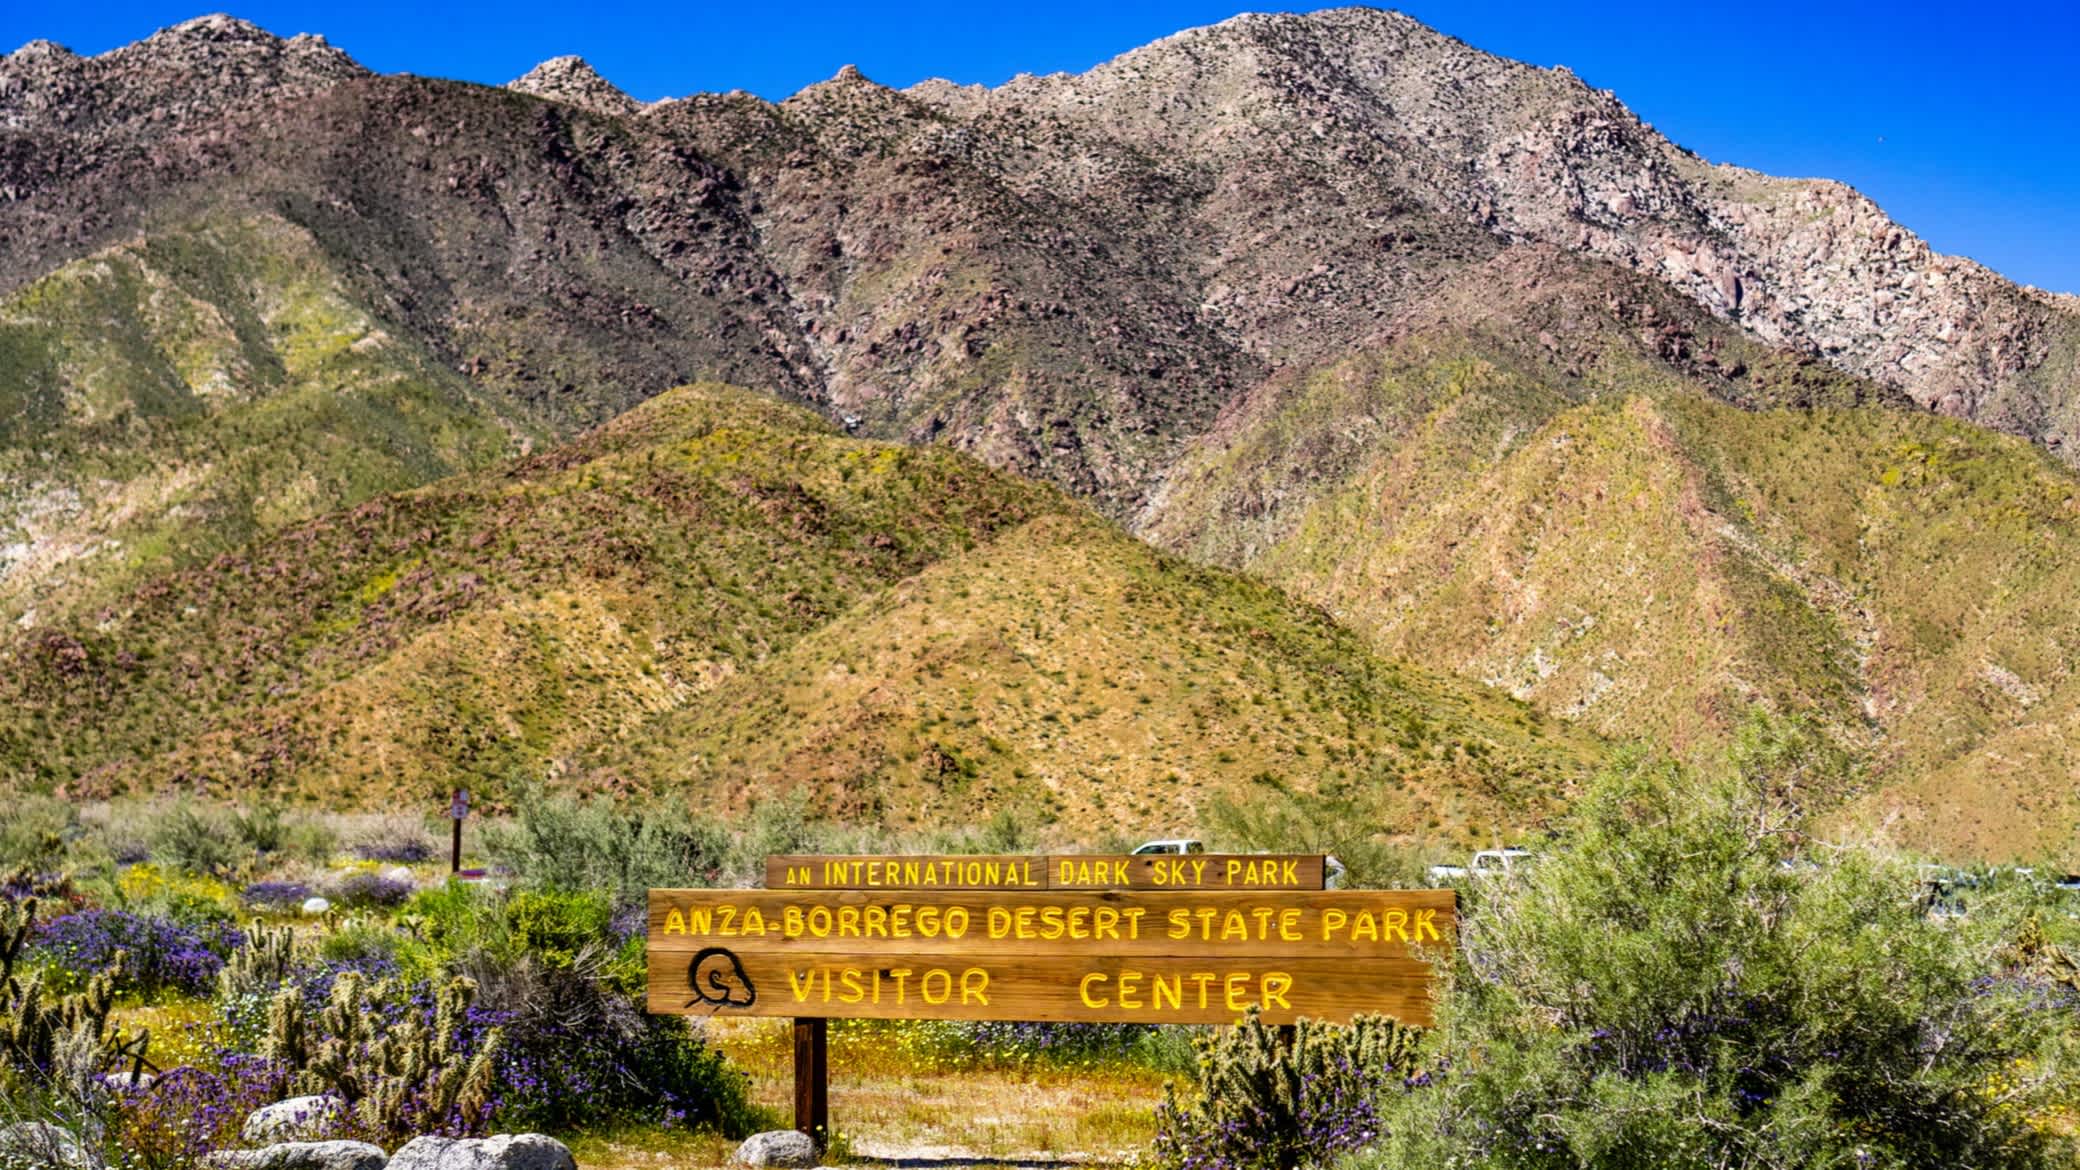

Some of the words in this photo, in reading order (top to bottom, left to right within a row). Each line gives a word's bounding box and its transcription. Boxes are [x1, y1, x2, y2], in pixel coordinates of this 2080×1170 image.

[785, 866, 811, 885] AN
[824, 861, 1039, 887] INTERNATIONAL
[1059, 860, 1131, 886] DARK
[1152, 860, 1207, 886] SKY
[1226, 860, 1300, 886] PARK
[663, 904, 970, 938] ANZA-BORREGO
[988, 906, 1145, 940] DESERT
[1167, 908, 1304, 941] STATE
[1322, 908, 1441, 942] PARK
[789, 967, 991, 1006] VISITOR
[1080, 971, 1294, 1012] CENTER
